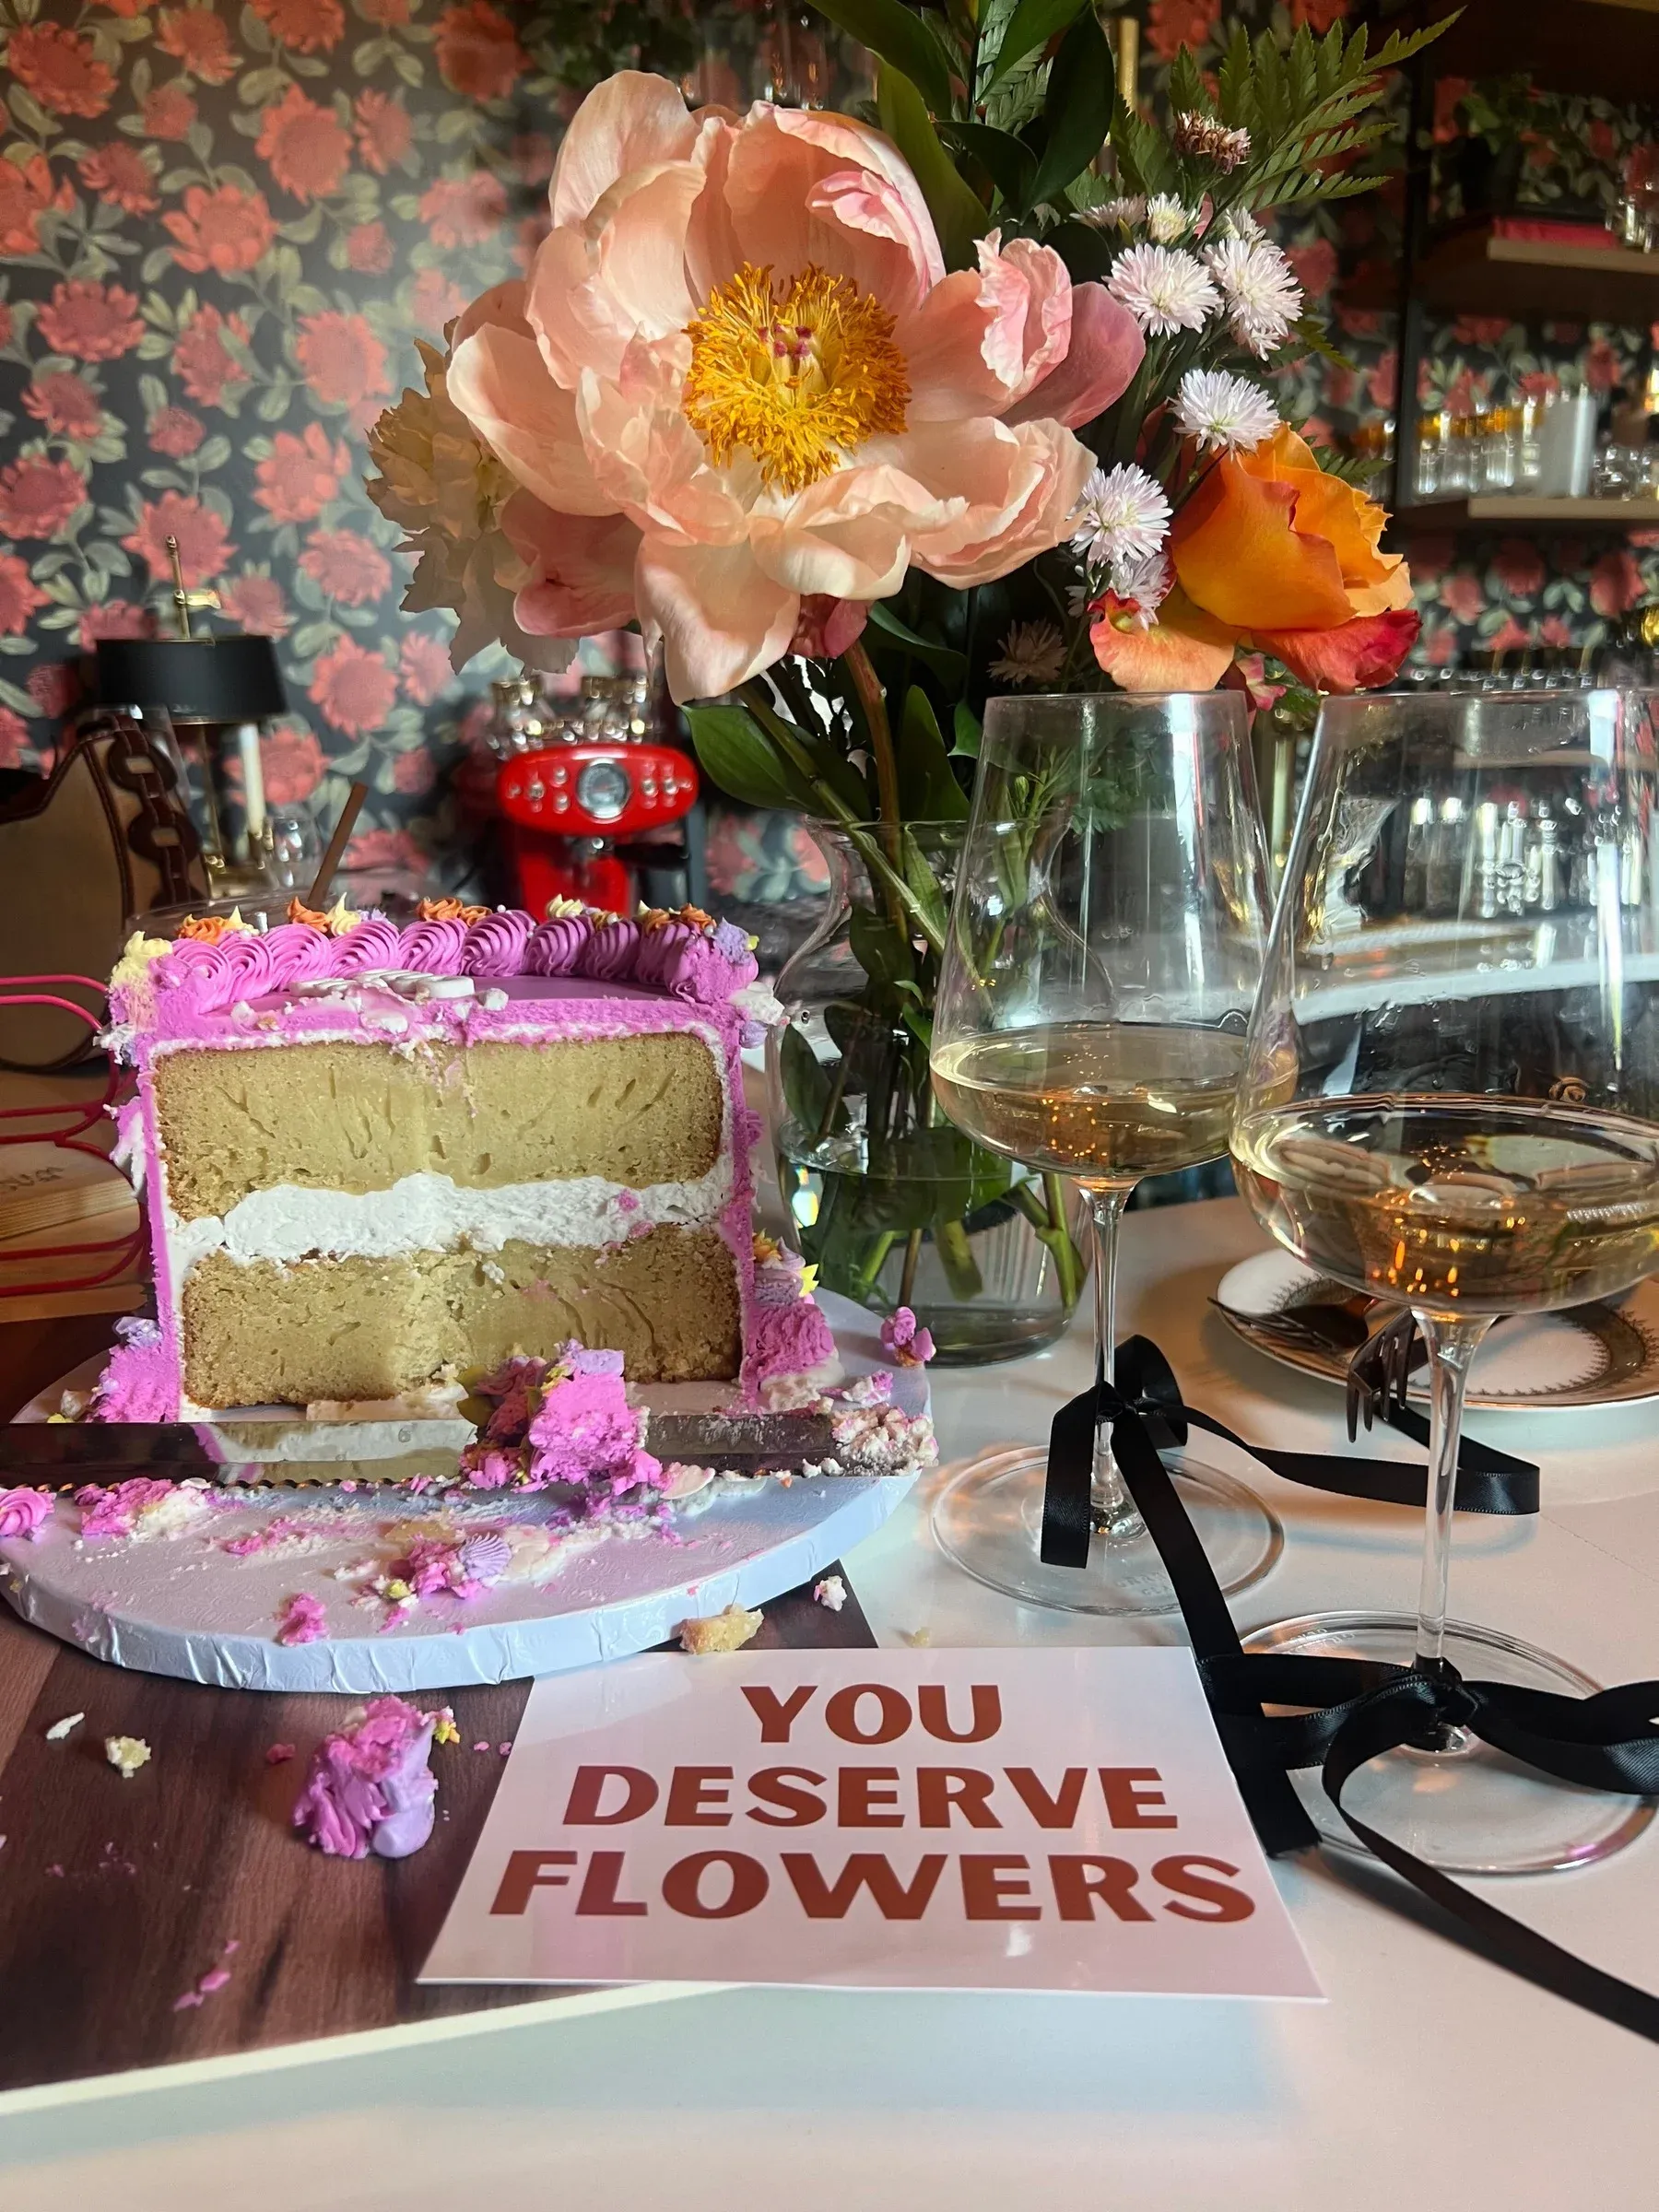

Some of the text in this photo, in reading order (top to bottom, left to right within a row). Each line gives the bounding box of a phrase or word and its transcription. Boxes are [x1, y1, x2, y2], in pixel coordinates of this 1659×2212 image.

[741, 1684, 1002, 1745] YOU
[563, 1765, 1178, 1830] DESERVE
[490, 1850, 1255, 1924] FLOWERS
